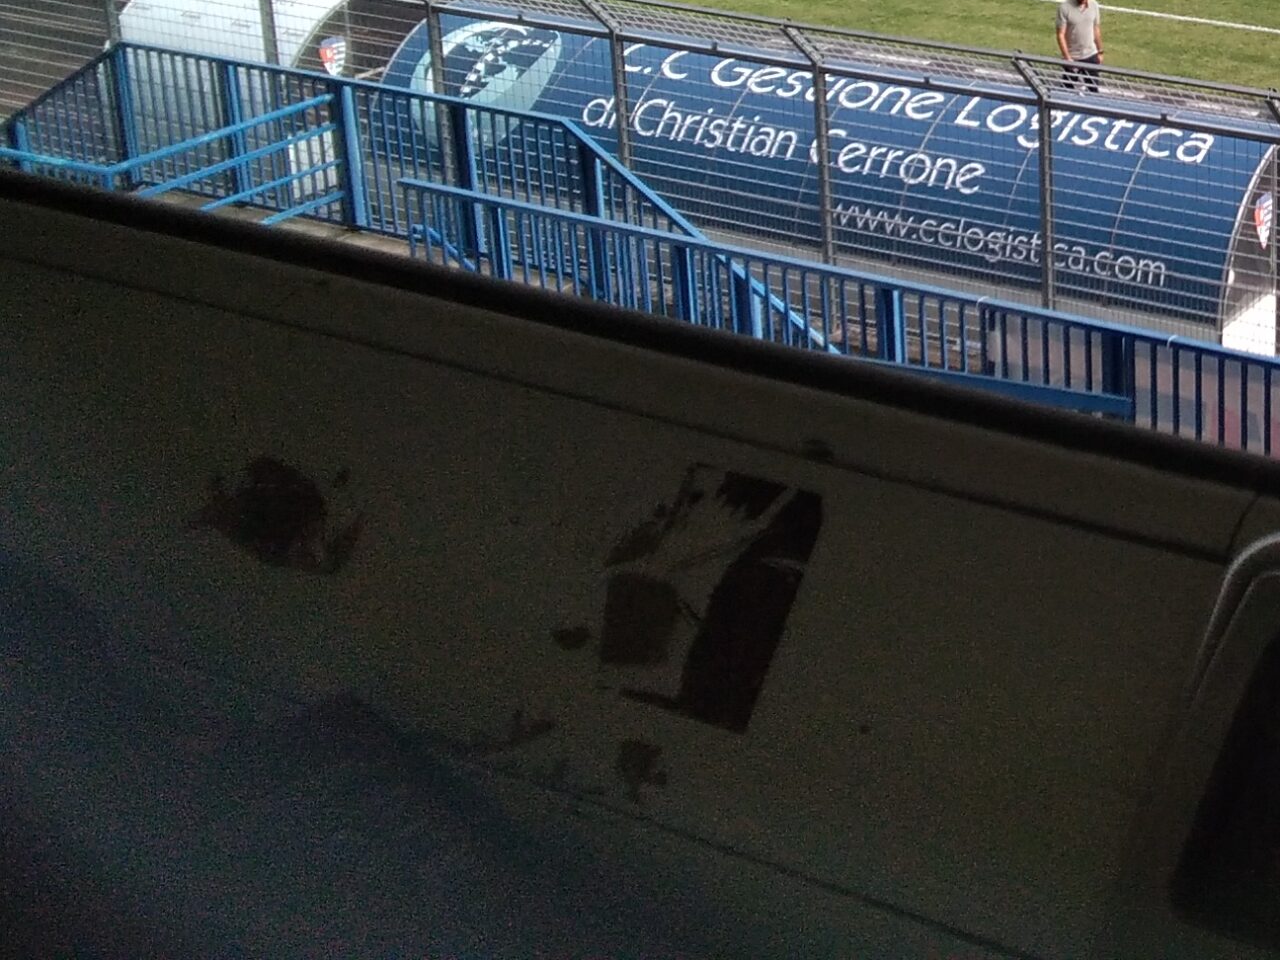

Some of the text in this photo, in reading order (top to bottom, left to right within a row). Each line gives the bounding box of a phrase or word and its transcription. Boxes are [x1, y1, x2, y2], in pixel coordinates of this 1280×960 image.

[633, 98, 798, 161] Christian
[810, 129, 986, 195] Cerrone
[711, 58, 945, 120] Gestione
[954, 96, 1215, 164] Logistica
[832, 202, 1167, 288] www.cclogistca.com
